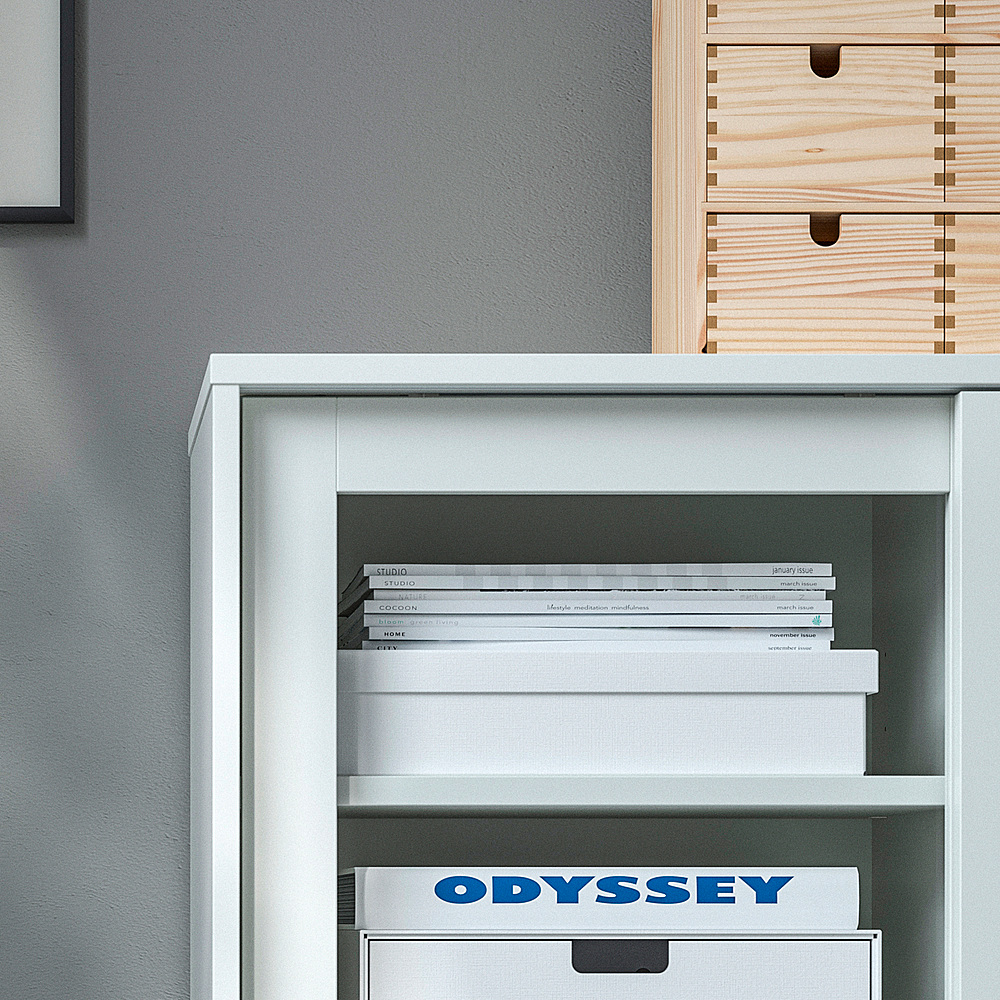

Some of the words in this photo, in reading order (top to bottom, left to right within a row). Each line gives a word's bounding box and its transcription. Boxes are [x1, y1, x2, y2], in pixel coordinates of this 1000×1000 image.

[376, 568, 408, 576] STUDIO
[772, 566, 796, 575] january
[797, 566, 814, 574] issue
[434, 875, 795, 904] ODYSSEY
